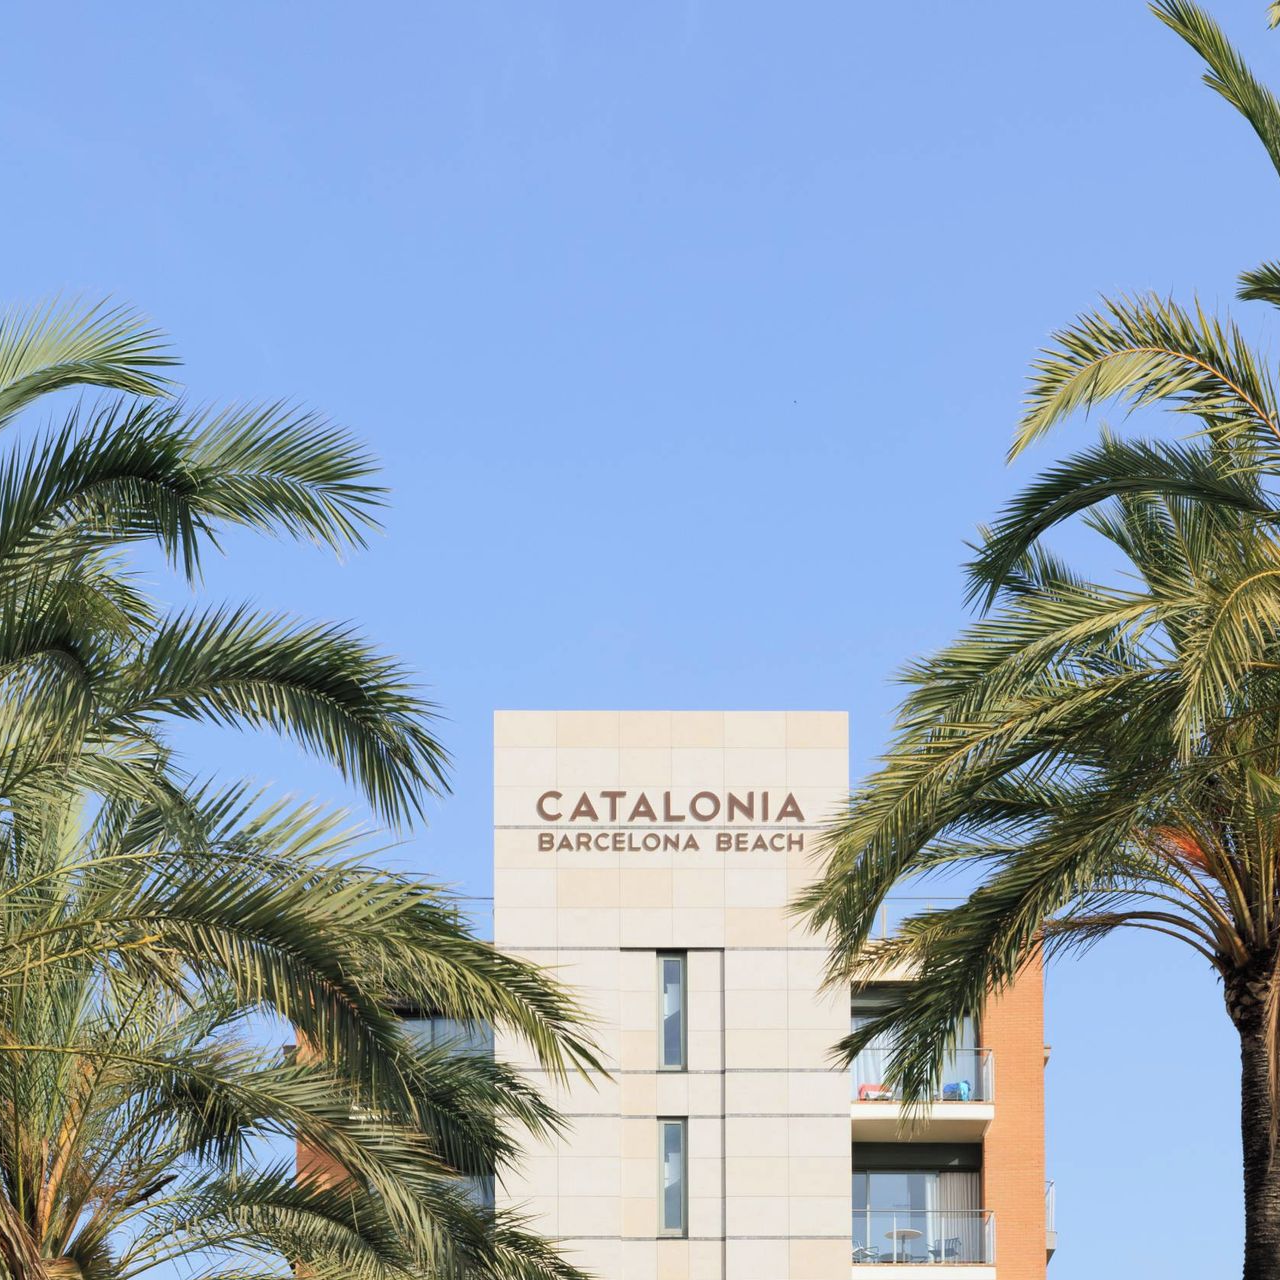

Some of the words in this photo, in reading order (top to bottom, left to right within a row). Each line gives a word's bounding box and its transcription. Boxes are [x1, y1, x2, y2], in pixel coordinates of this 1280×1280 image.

[535, 790, 806, 823] CATALONIA
[537, 832, 700, 852] BARCELONA
[715, 832, 805, 852] BEACH
